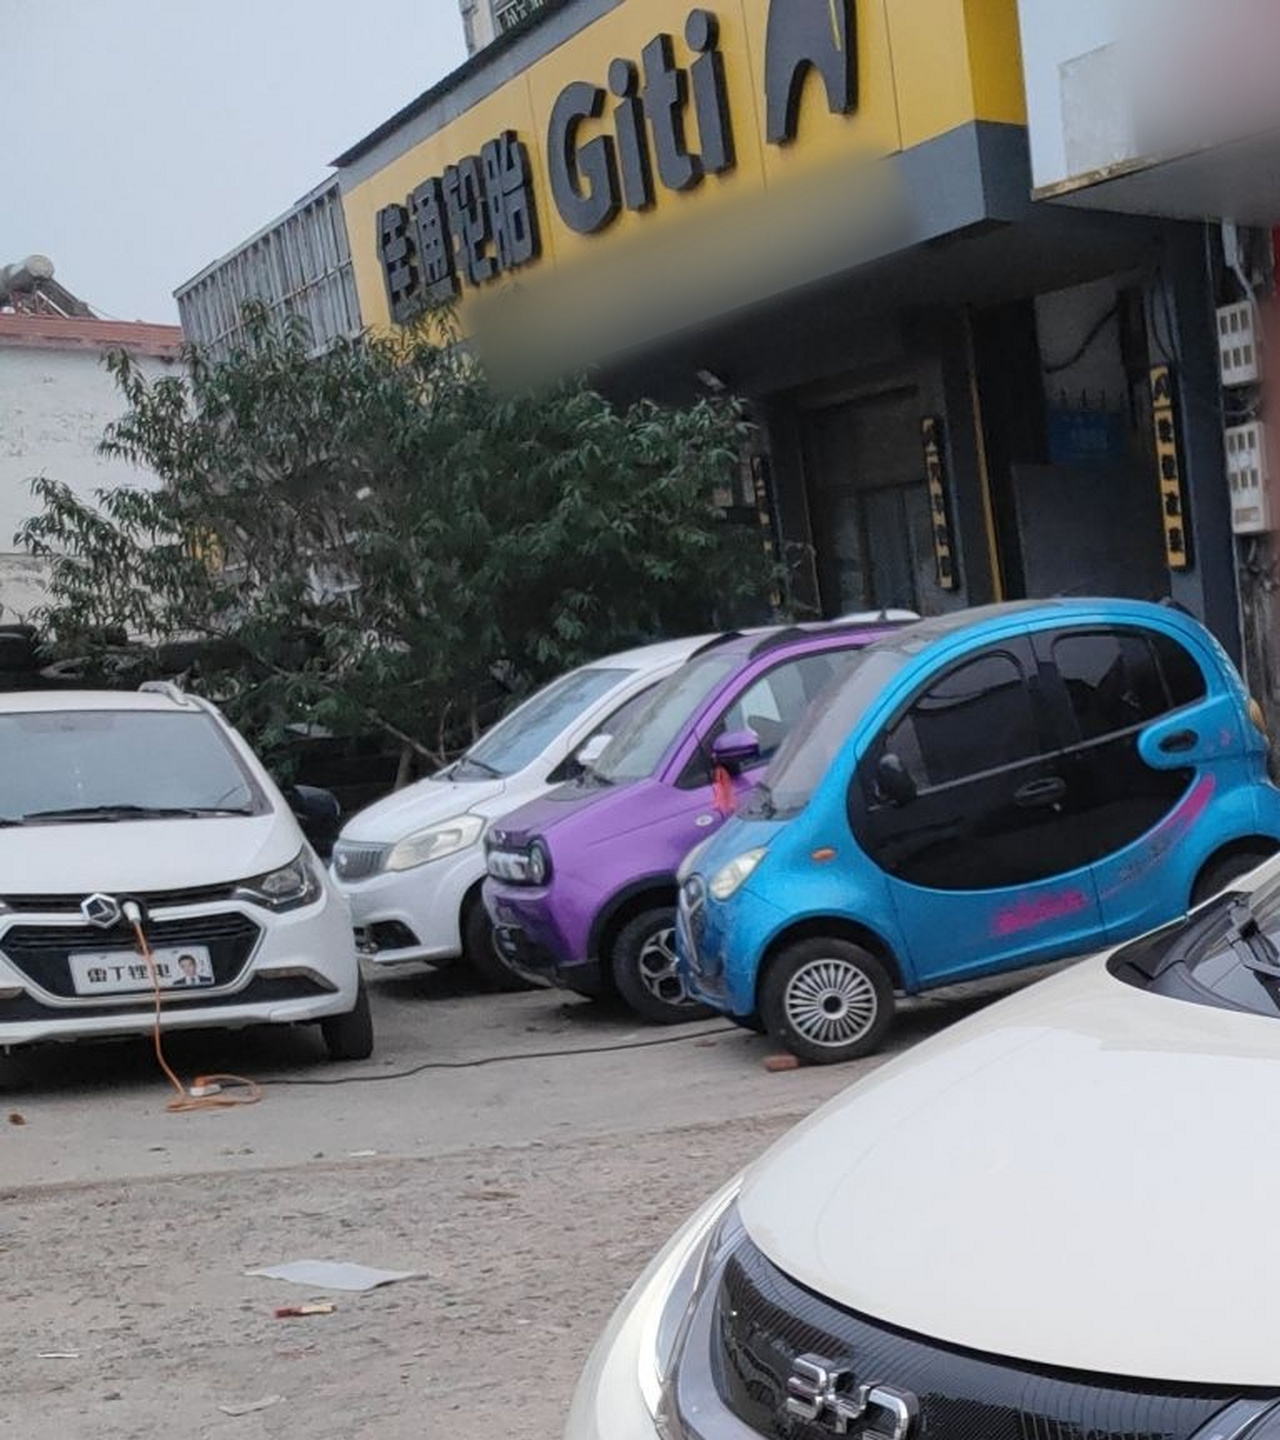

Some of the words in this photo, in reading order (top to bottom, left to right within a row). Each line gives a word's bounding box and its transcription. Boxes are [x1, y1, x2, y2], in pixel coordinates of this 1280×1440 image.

[548, 9, 735, 235] Giti
[376, 130, 542, 325] 佳通轮胎
